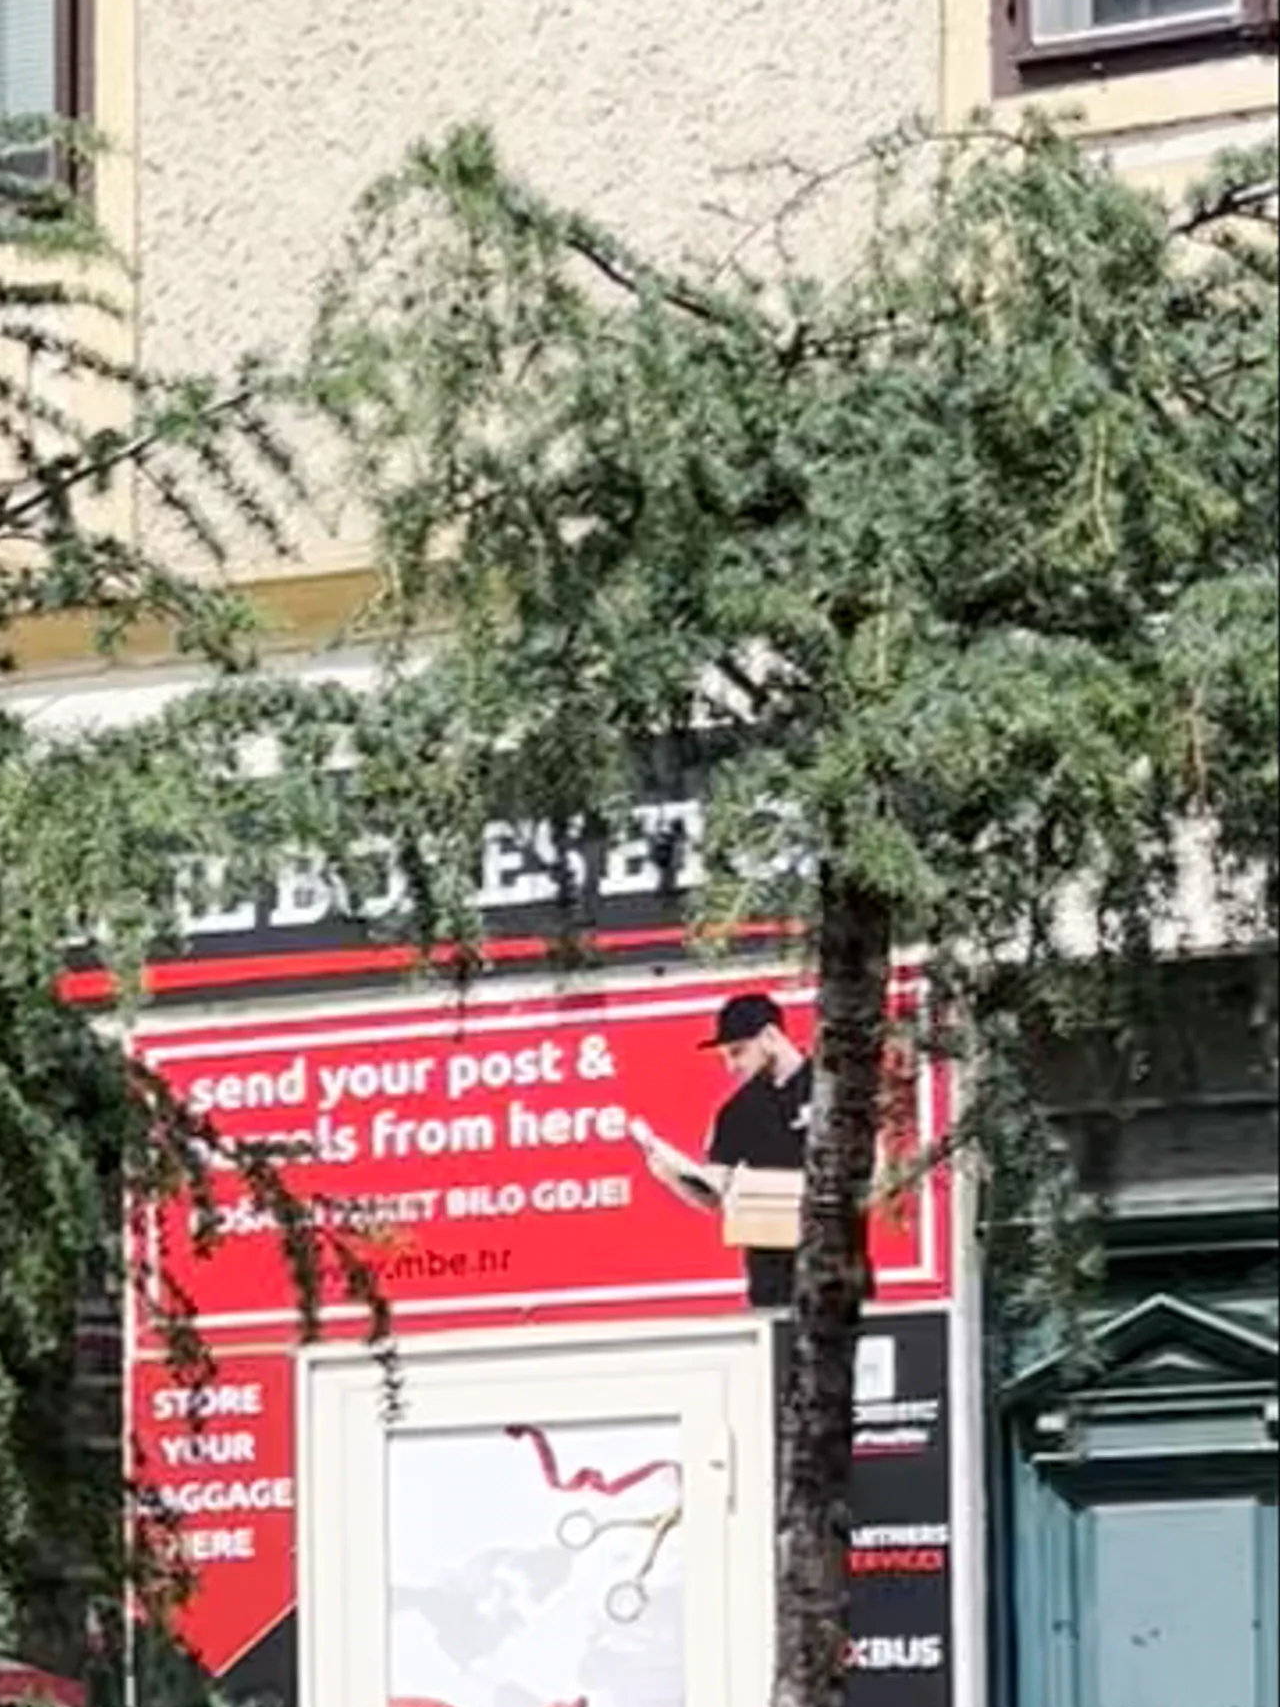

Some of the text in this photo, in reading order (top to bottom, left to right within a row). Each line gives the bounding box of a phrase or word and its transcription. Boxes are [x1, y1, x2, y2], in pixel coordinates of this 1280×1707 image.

[188, 1034, 615, 1113] send your post &
[372, 1109, 493, 1159] from
[508, 1101, 628, 1147] here
[446, 1183, 525, 1218] BILO
[532, 1176, 630, 1211] GDJE!
[153, 1384, 264, 1420] STORE
[161, 1431, 256, 1467] YOUR
